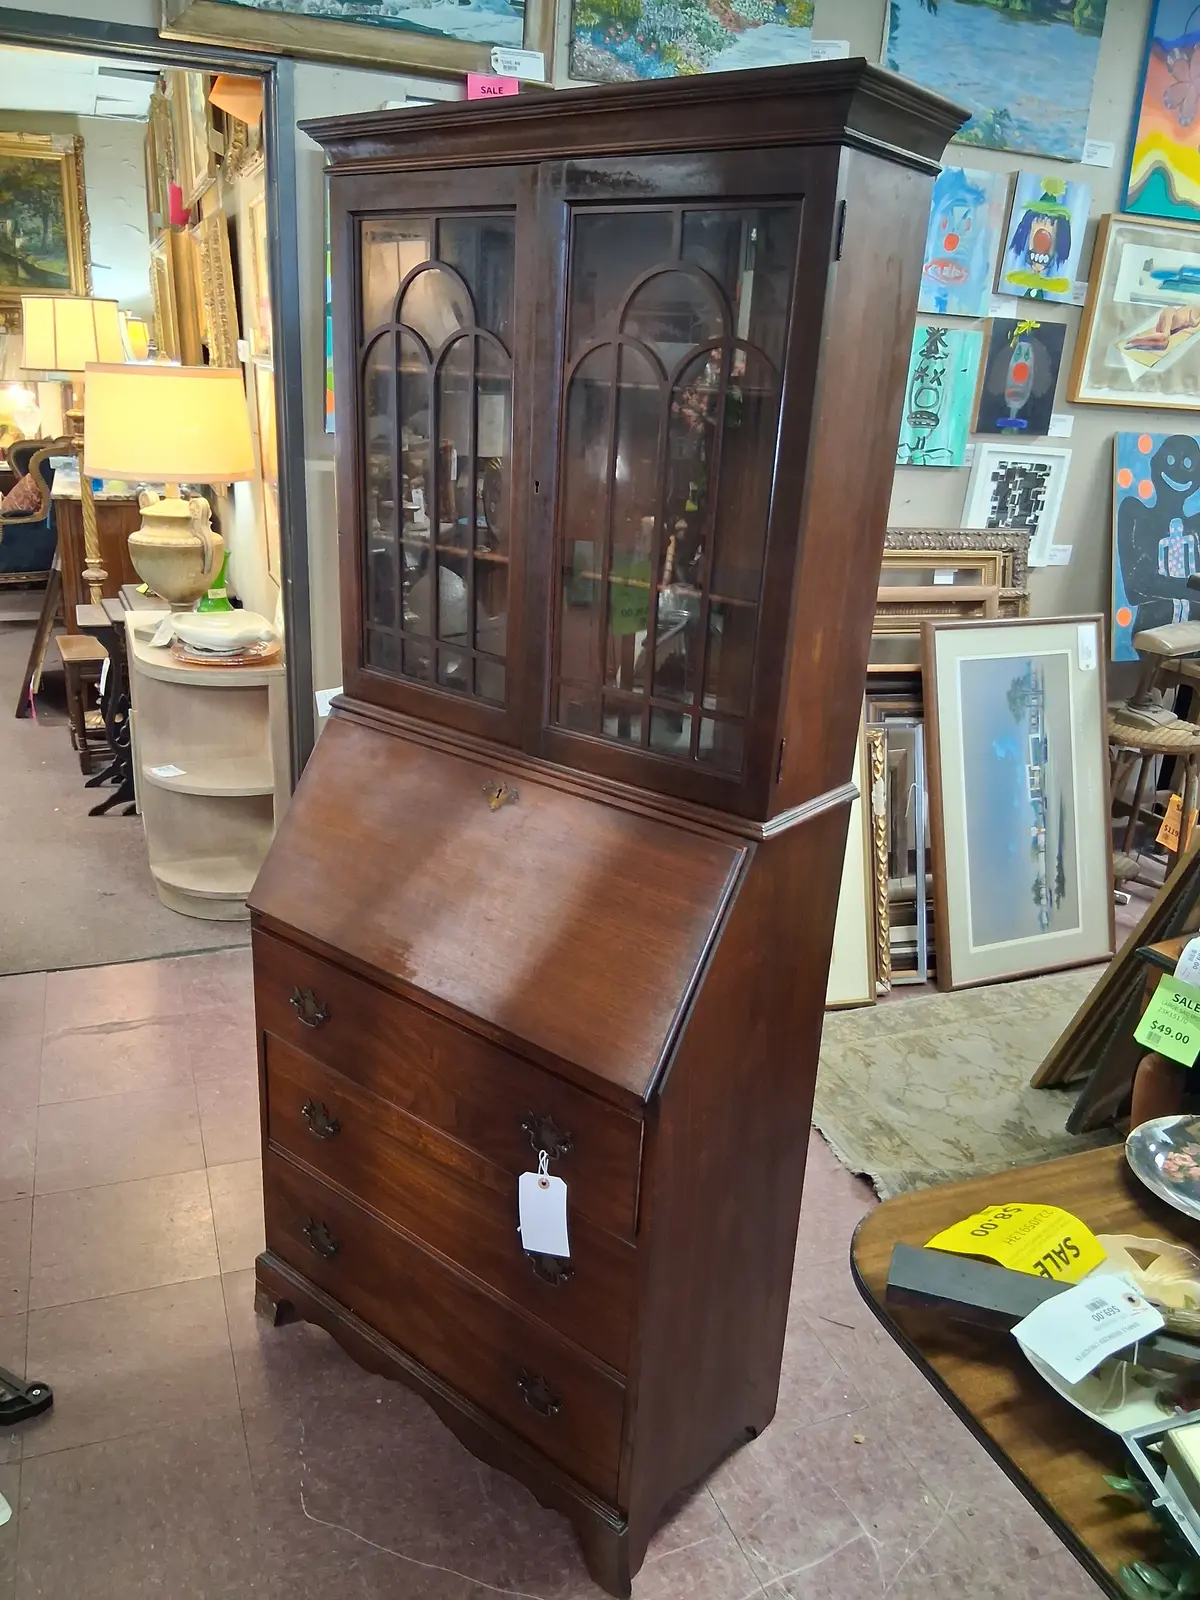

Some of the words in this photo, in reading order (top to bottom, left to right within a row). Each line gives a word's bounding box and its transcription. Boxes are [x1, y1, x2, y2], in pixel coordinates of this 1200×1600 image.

[480, 86, 504, 95] SALE
[1172, 993, 1200, 1014] SALE
[1150, 1020, 1190, 1045] $49.00
[969, 1206, 1022, 1238] $8.00
[1032, 1236, 1080, 1280] SALE
[1091, 1305, 1120, 1322] $69.00
